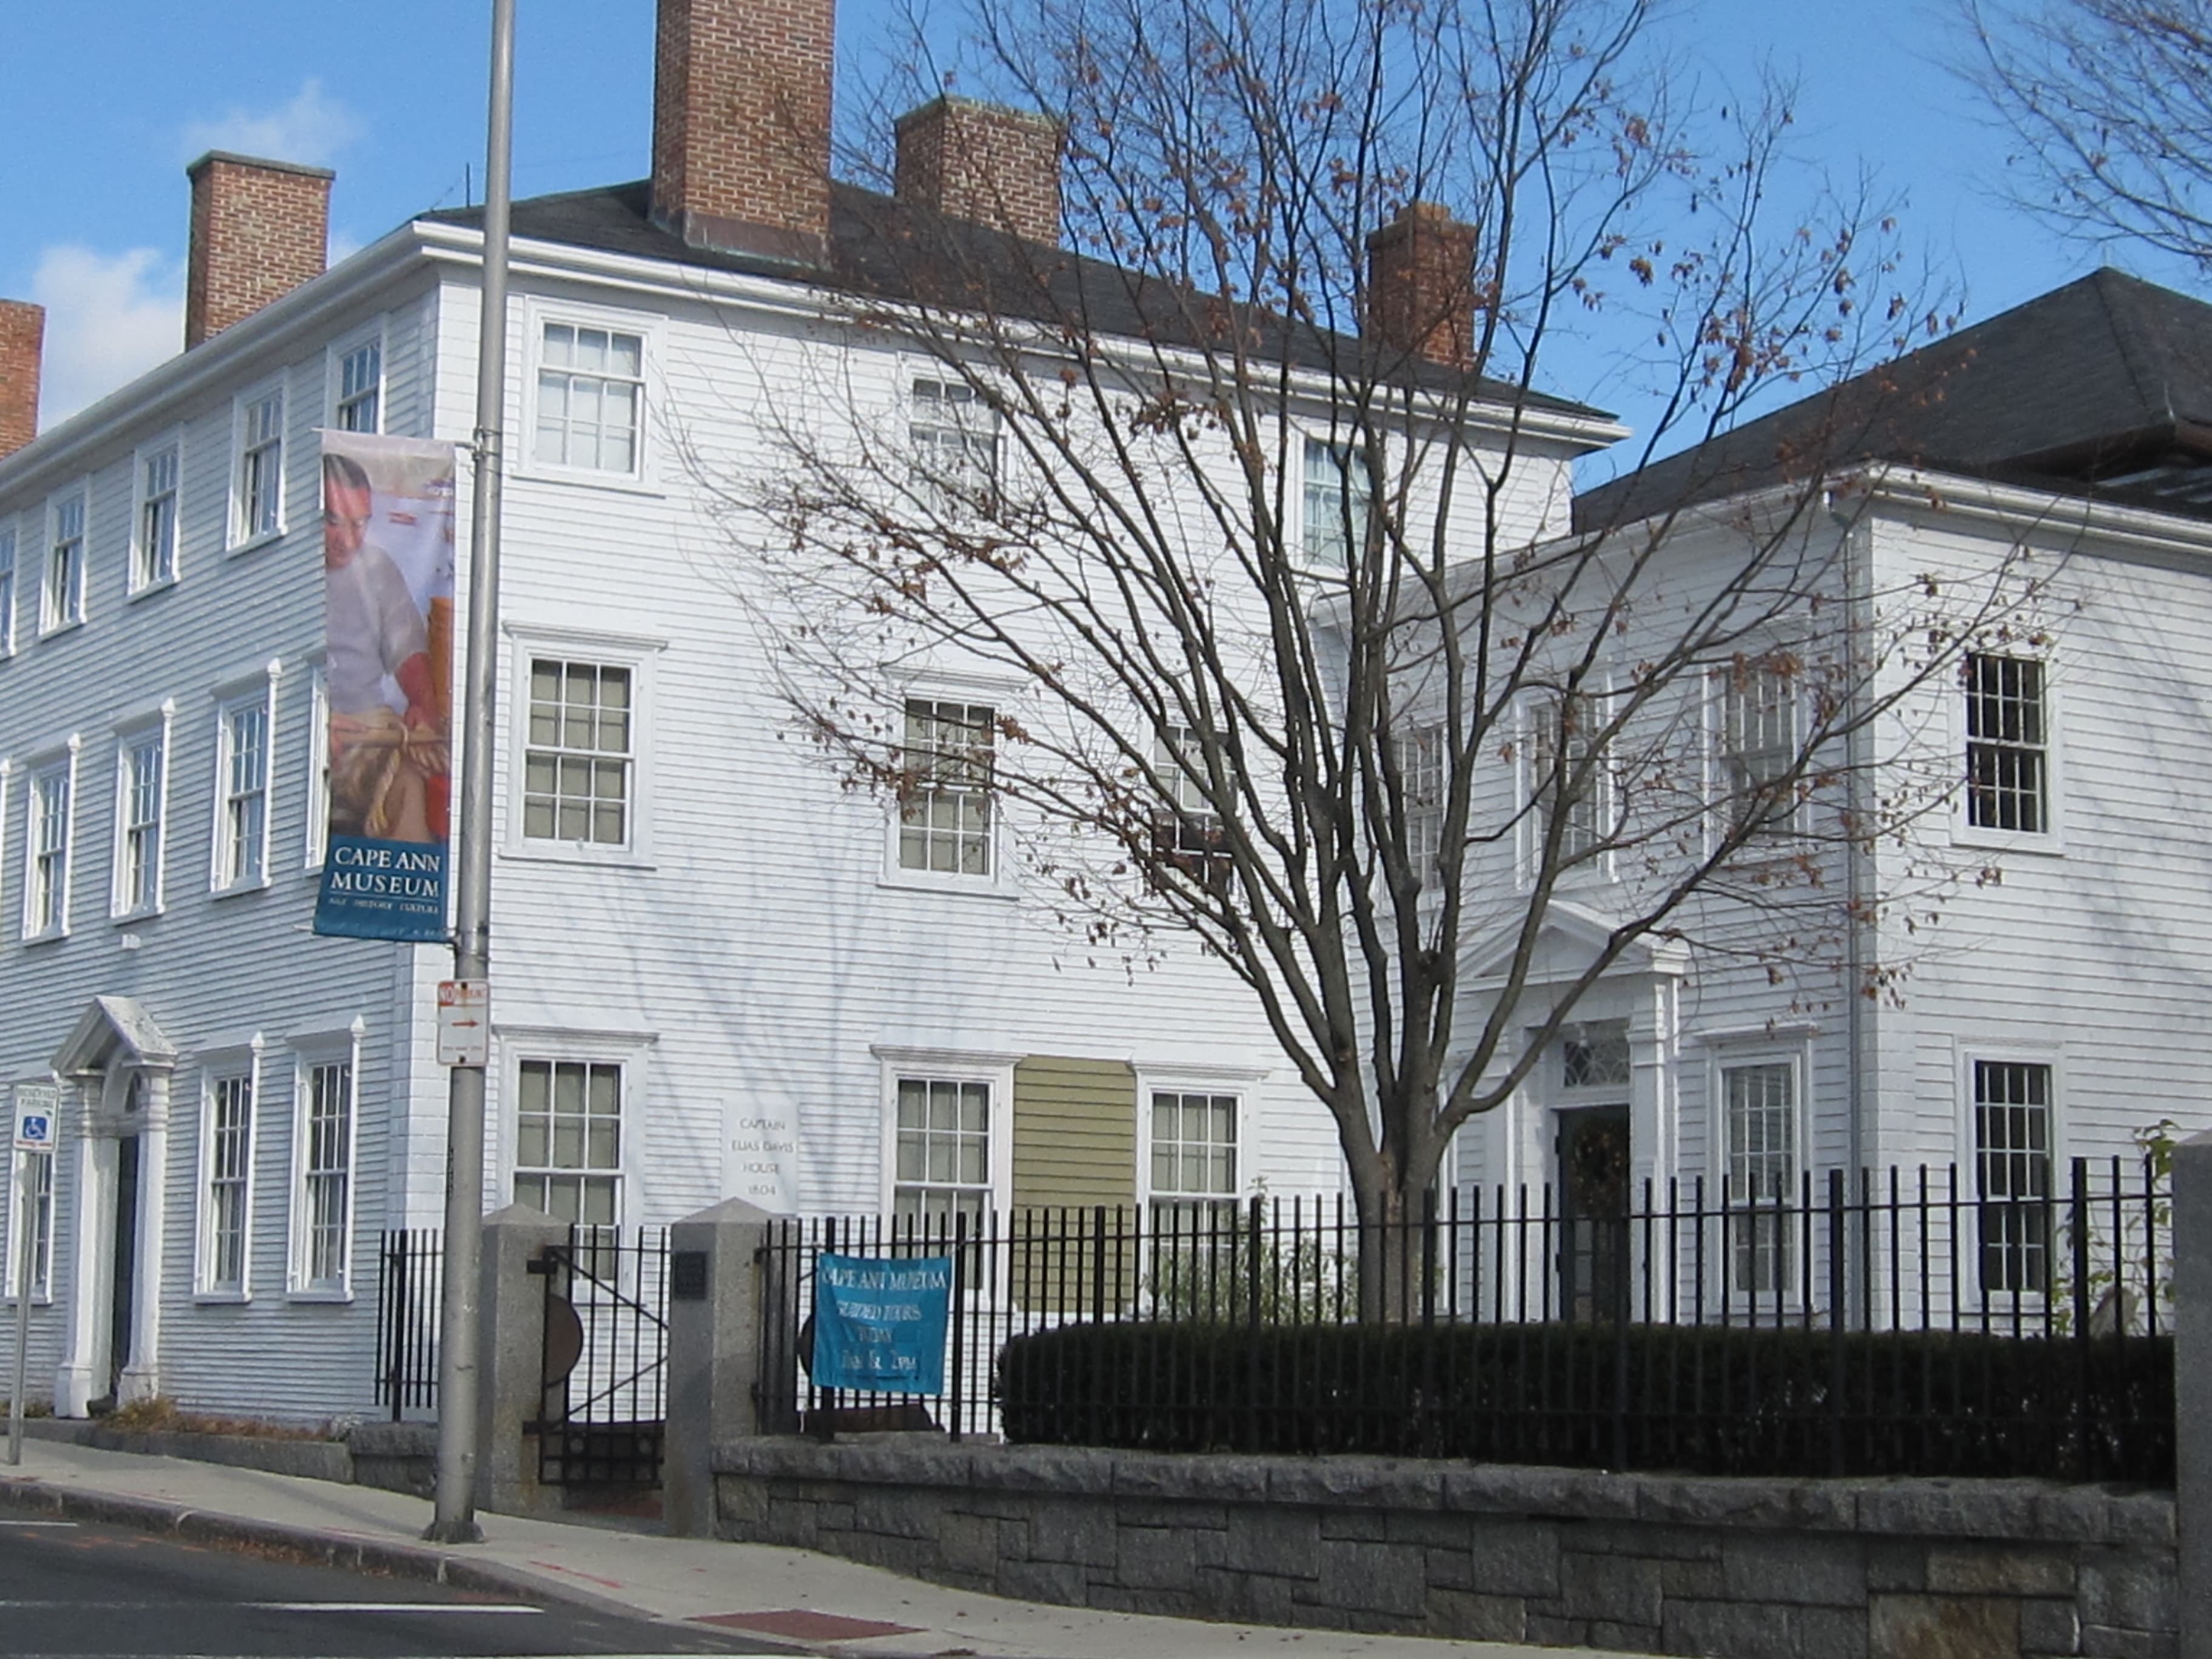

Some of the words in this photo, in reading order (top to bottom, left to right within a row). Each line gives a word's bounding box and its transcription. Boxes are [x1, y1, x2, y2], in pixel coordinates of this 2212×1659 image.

[335, 846, 392, 868] CAPE
[396, 852, 441, 872] ANN
[330, 872, 439, 897] MUSEUM
[739, 1117, 786, 1131] CAPTAIN
[731, 1139, 760, 1152] ELIAS
[762, 1142, 794, 1153] DAVIS
[743, 1162, 780, 1175] HOUSE
[822, 1265, 856, 1287] CAPE
[859, 1270, 885, 1290] ANN
[889, 1270, 947, 1291] MUSEUM
